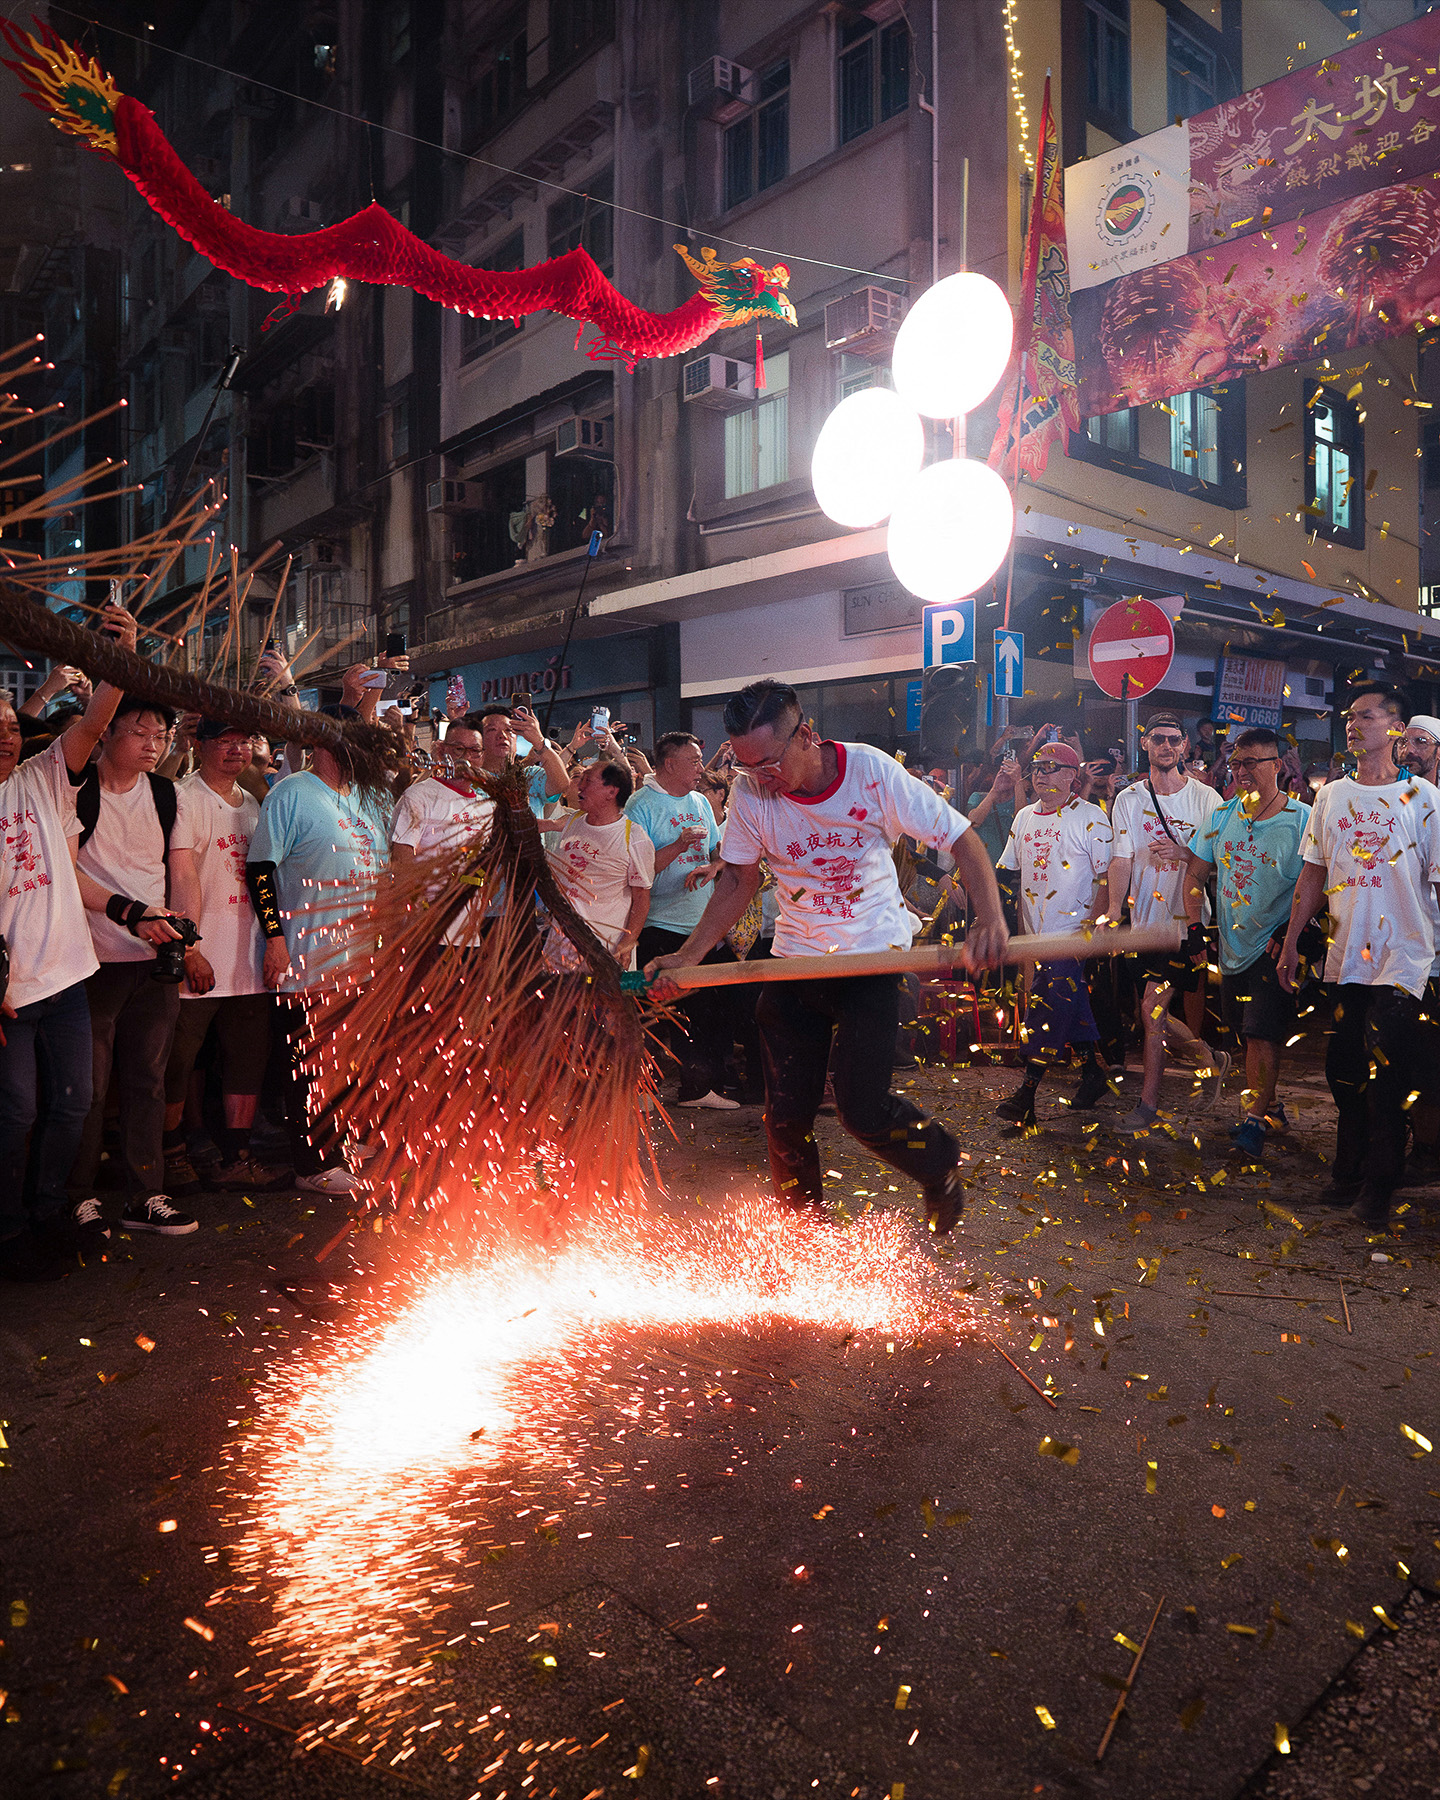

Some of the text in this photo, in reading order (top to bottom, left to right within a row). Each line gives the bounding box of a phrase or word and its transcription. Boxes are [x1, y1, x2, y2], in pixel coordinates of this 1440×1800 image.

[1284, 55, 1440, 155] 大坑
[931, 610, 966, 666] P
[1250, 708, 1279, 726] 0688
